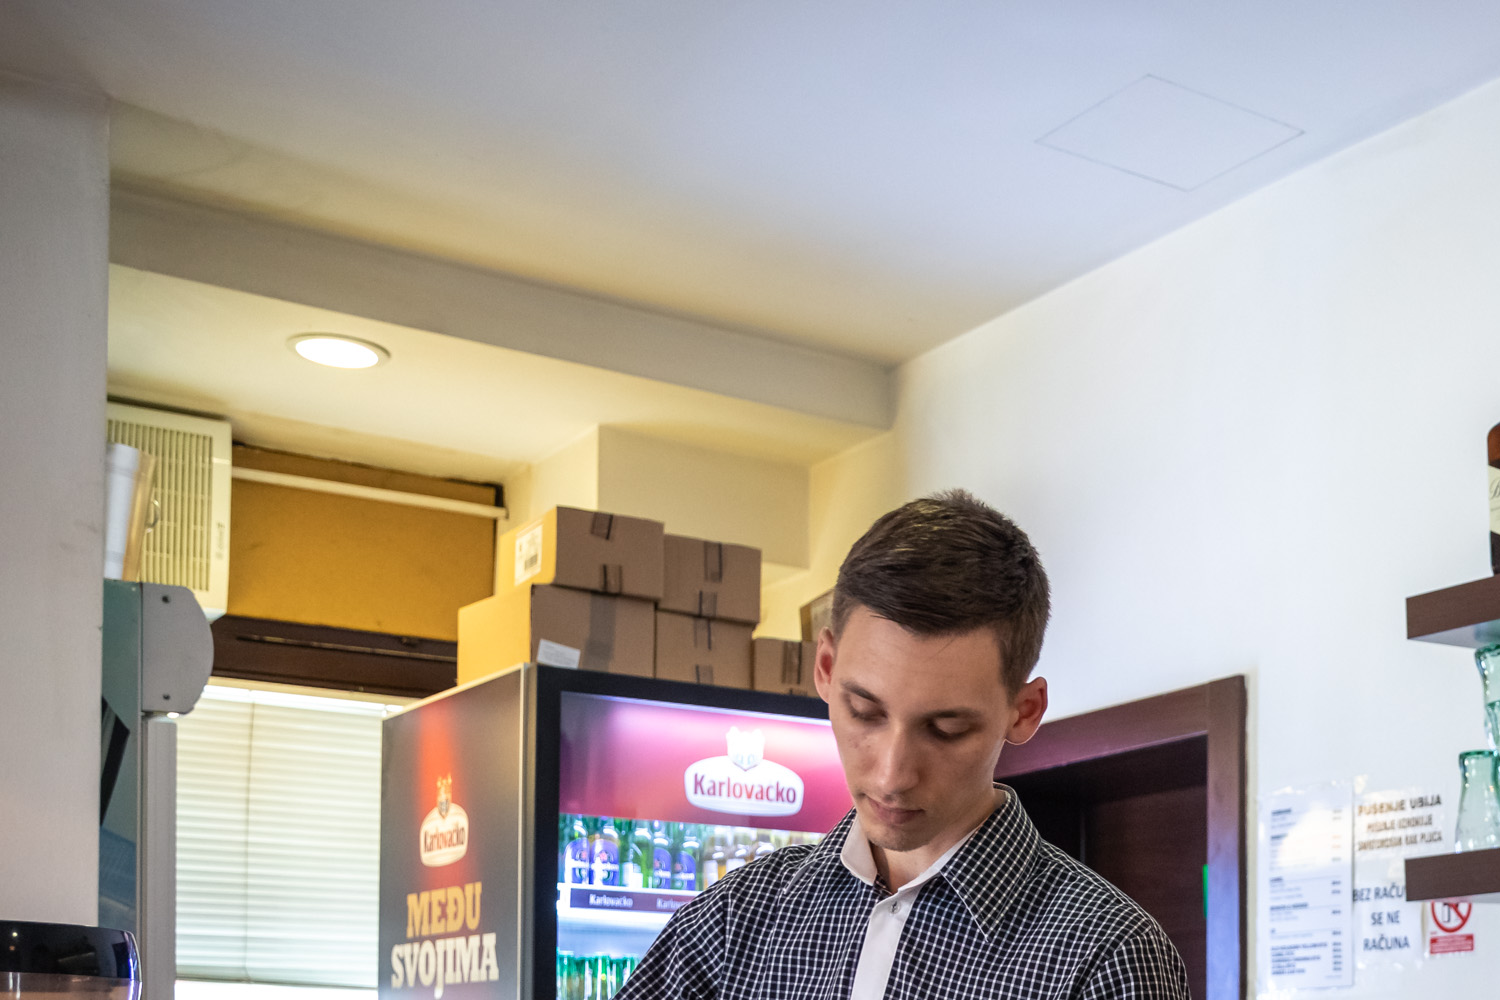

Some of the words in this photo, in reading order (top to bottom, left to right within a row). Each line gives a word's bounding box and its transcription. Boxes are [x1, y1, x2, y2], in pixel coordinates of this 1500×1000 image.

[1353, 887, 1370, 902] BEZ
[1374, 881, 1405, 899] RAČU
[406, 882, 483, 938] MEĐU
[1371, 912, 1382, 925] SE
[1387, 910, 1400, 923] NE
[1364, 935, 1410, 951] RAČUNA
[391, 933, 499, 999] SVOJIMA
